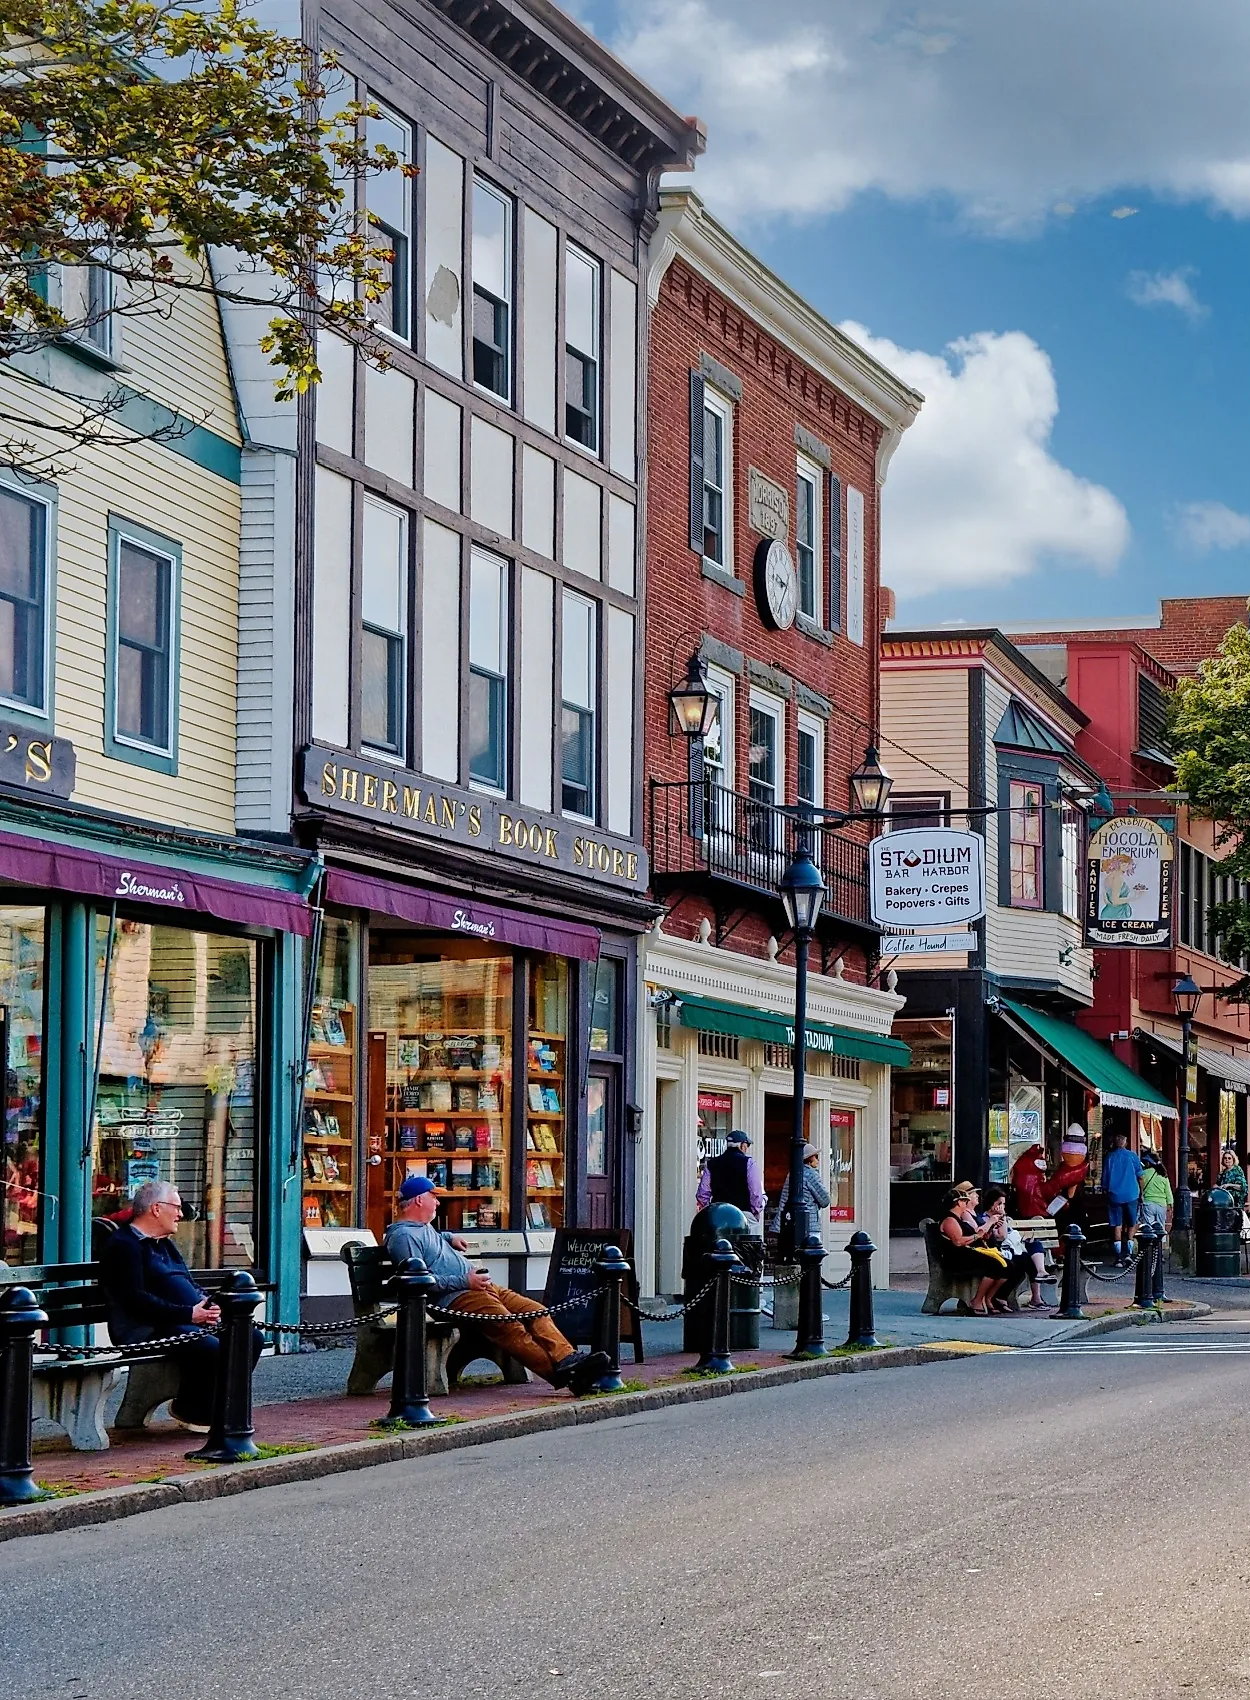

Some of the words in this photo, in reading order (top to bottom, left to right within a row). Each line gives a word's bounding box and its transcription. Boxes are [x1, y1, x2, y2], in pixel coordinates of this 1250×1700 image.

[321, 762, 482, 837] SHERMAN'S
[499, 813, 559, 859] BOOK
[573, 836, 638, 881] STORE
[1102, 847, 1159, 858] EMPORIUM
[885, 869, 909, 879] BAR
[922, 866, 970, 877] HARBOR
[116, 872, 185, 902] Sherman's
[885, 886, 922, 896] Bakery
[931, 884, 969, 894] Crepes
[1089, 860, 1097, 917] CANDIES
[886, 899, 936, 910] Popovers
[945, 896, 970, 906] Gifts
[450, 910, 496, 936] Sherman's
[1102, 921, 1117, 929] ICE
[1122, 921, 1154, 929] CREAM
[884, 939, 915, 952] Coffee
[919, 935, 947, 951] Hound
[1096, 932, 1115, 941] MADE
[1118, 932, 1138, 941] FRESH
[1140, 934, 1160, 942] DAILY
[785, 1026, 795, 1043] Th
[804, 1031, 834, 1051] TADIUM
[1009, 1126, 1037, 1139] ough
[561, 1256, 597, 1266] SHERMA
